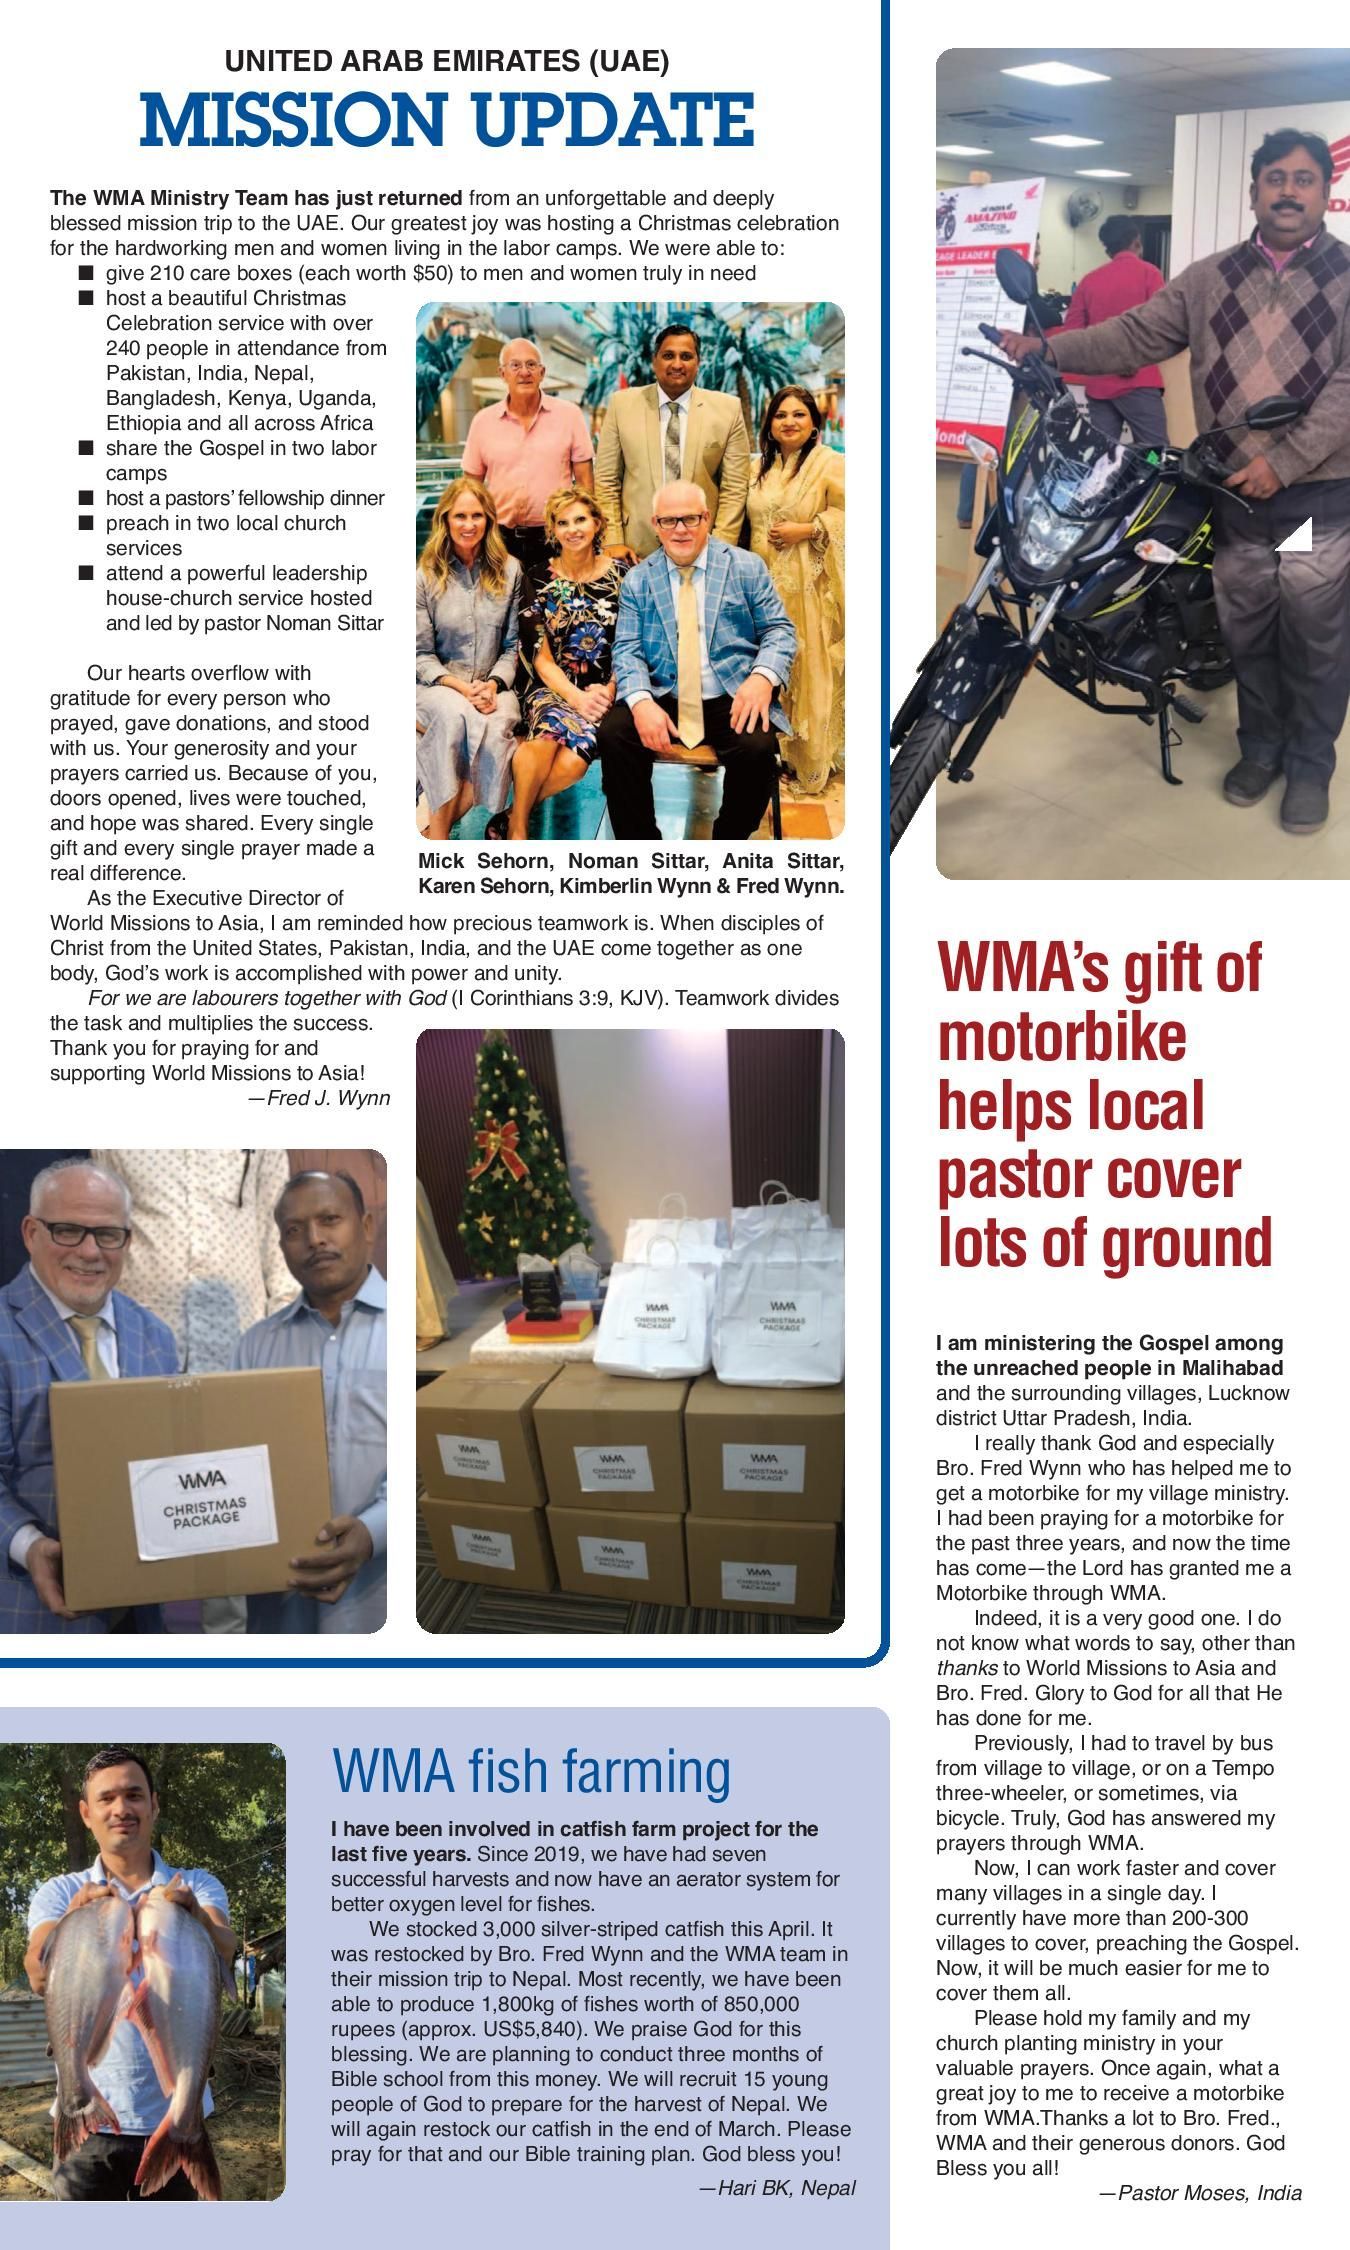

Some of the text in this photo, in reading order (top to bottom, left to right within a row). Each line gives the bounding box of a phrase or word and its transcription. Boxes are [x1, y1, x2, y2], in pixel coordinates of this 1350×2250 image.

[226, 49, 669, 77] UNITED ARAB EMIRATES (UAE)
[140, 91, 754, 147] MISSION UPDATE
[50, 190, 774, 210] The WMA Ministry Team has just returned from an unforgettable and deeply
[1328, 198, 1350, 213] D
[958, 249, 989, 260] LEADER
[107, 264, 755, 285] give 210 care boxes (each worth $50) to men and women truly in need
[107, 290, 346, 305] host a beautiful Christmas
[107, 315, 373, 331] Celebration service with over
[108, 365, 313, 384] Pakistan, India, Nepal,
[107, 390, 375, 410] Bangladesh, Kenya, Uganda,
[936, 428, 967, 445] ond
[419, 852, 843, 871] Mick Sehorn, Noman Sittar, Anita Sittar,
[420, 877, 844, 898] Karen Sehorn, Kimberlin Wynn & Fred Wynn.
[938, 941, 1262, 1004] WMA’s gift of
[89, 990, 839, 1010] For we are labourers together with God (I Corinthians 3:9, KJV). Teamwork divides
[940, 1010, 1186, 1061] motorbike
[248, 1090, 391, 1111] —Fred J. Wynn
[940, 1079, 1203, 1142] helps local
[940, 1149, 1242, 1210] pastor cover
[941, 1216, 1271, 1279] lots of ground
[770, 1301, 797, 1311] WMA
[760, 1317, 806, 1325] CHRISTMAS
[763, 1324, 801, 1332] PACKAGE
[937, 1335, 1283, 1355] I am ministering the Gospel among
[936, 1360, 1283, 1379] the unreached people in Malihabad
[750, 1453, 779, 1463] WMA
[178, 1470, 227, 1490] WMA
[739, 1467, 789, 1475] CHRISTMAS
[163, 1497, 247, 1518] CHRISTMAS
[173, 1511, 240, 1530] PACKAGE
[333, 1748, 729, 1803] WMA fish farming
[332, 1821, 818, 1841] I have been involved in catfish farm project for the
[936, 1910, 1248, 1930] currently have more than 200-300
[699, 2180, 857, 2200] —Hari BK, Nepal
[1099, 2185, 1303, 2204] —Pastor Moses, India
